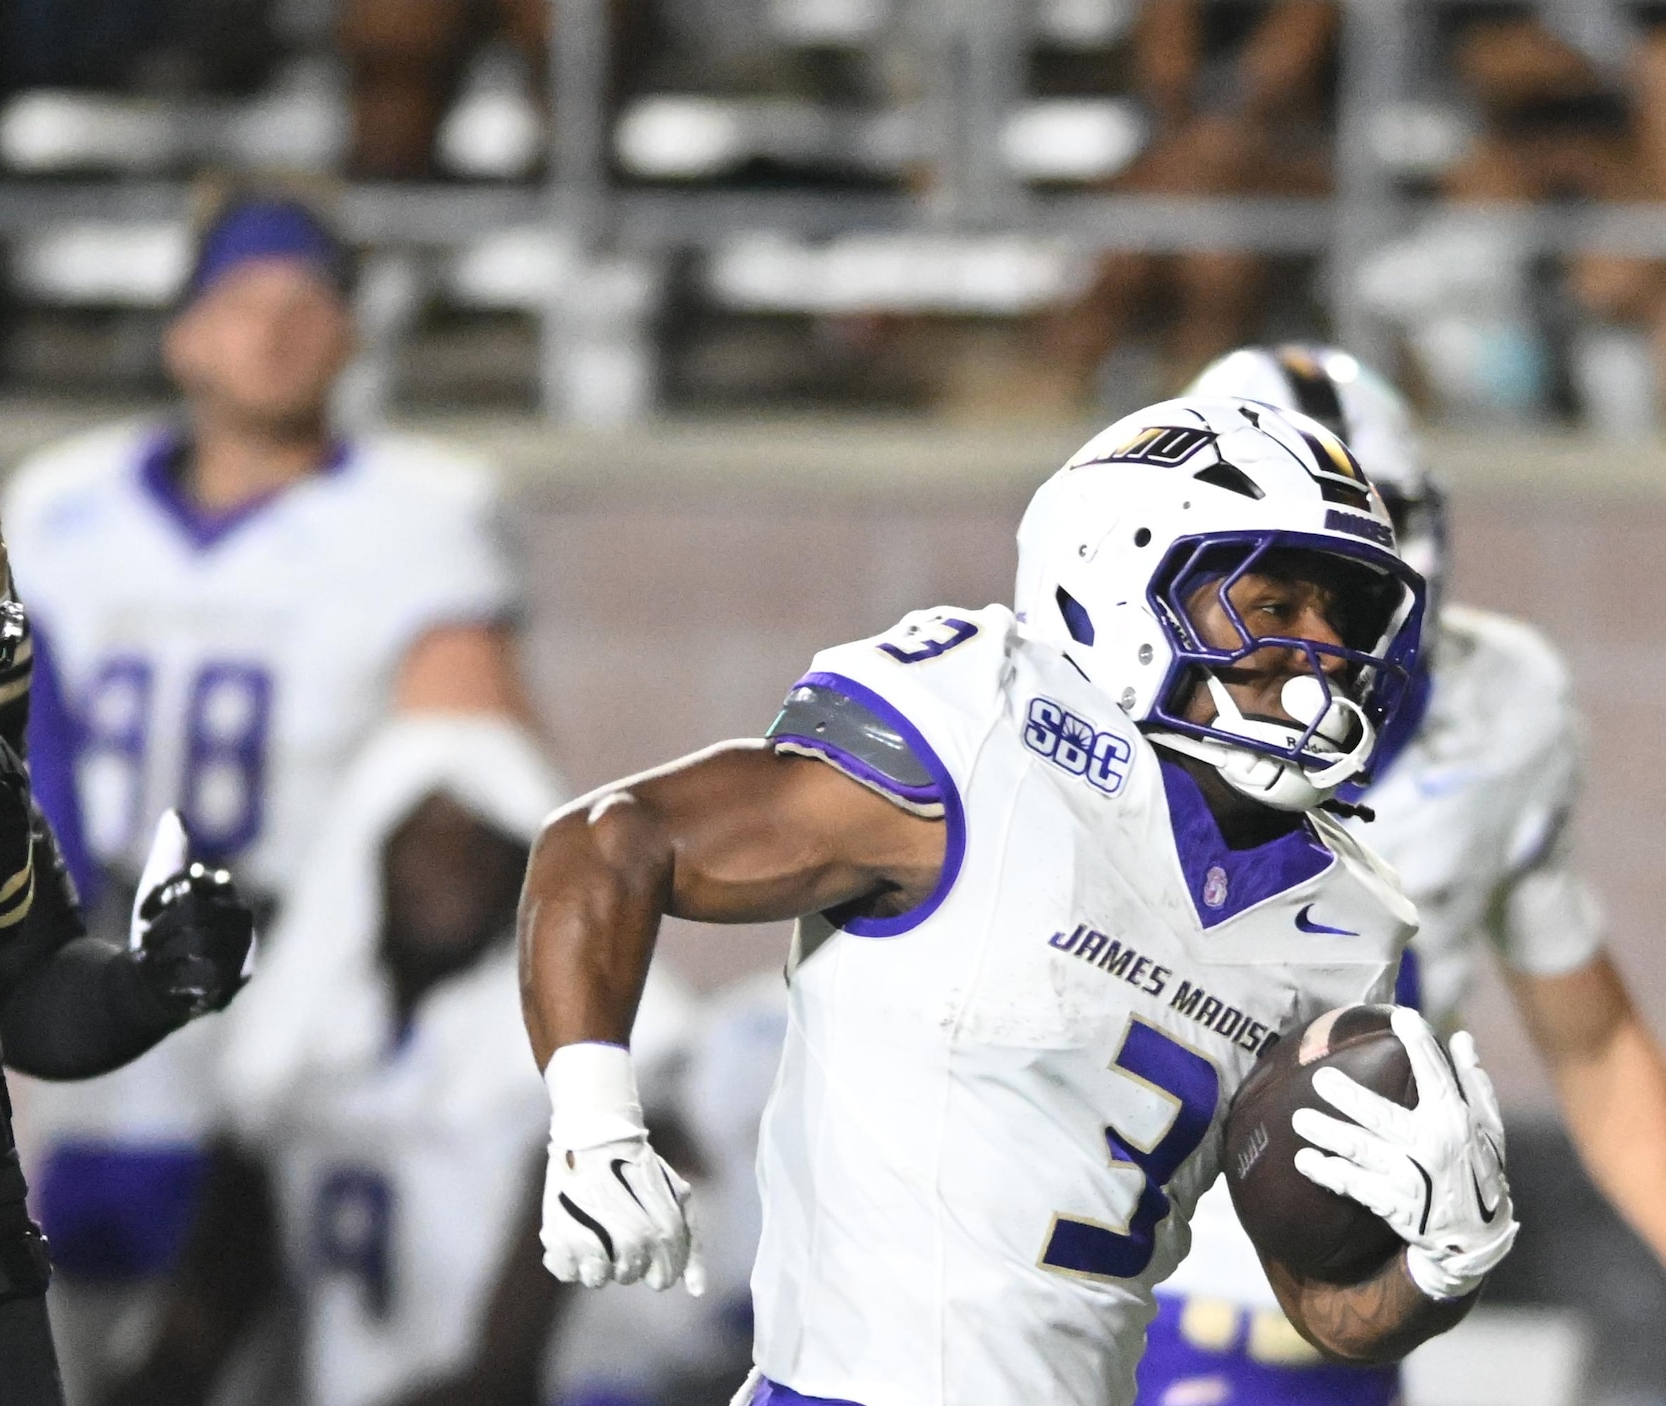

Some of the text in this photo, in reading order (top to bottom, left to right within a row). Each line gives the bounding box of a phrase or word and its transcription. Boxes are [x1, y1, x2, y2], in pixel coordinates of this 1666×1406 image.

[875, 617, 983, 667] 3
[1023, 697, 1133, 795] SBC
[1047, 922, 1173, 997] JAMES
[1036, 1010, 1223, 1283] 3
